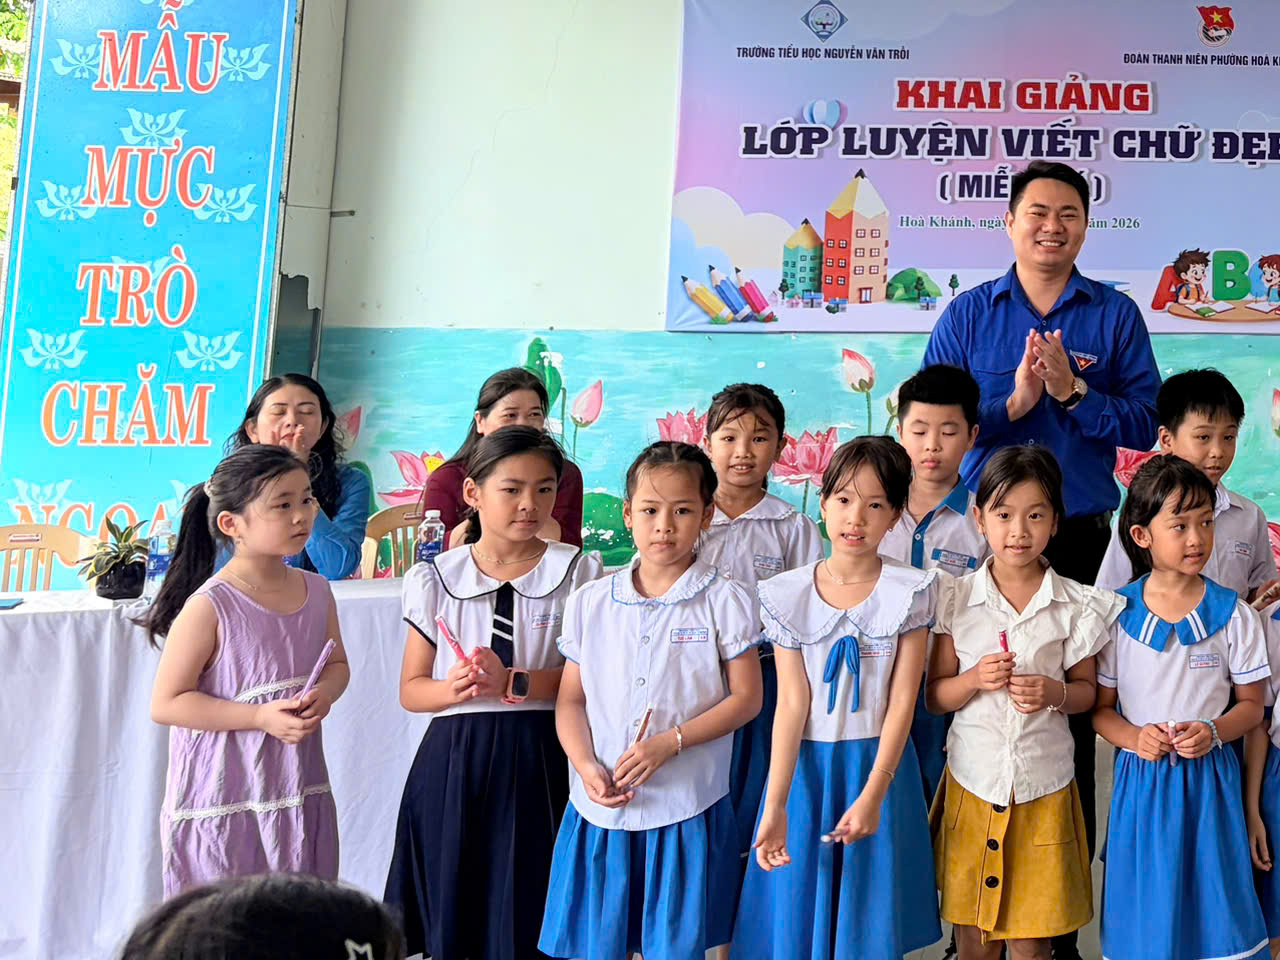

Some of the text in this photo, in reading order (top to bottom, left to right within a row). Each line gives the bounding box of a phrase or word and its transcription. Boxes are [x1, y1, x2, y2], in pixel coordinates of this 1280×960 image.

[736, 45, 775, 58] TRƯỜNG
[802, 47, 821, 61] HỌC
[1152, 53, 1183, 65] THANH
[1186, 52, 1208, 65] NIÊN
[895, 74, 1150, 112] KHAI GIẢNG
[742, 120, 829, 155] LỚP
[841, 121, 989, 162] LUYỆN
[1001, 118, 1100, 158] VIẾT
[1113, 125, 1202, 159] CHỮ
[80, 138, 217, 227] MỰC
[958, 166, 1011, 199] MIỄ
[899, 216, 925, 227] Hoà
[929, 216, 975, 229] Khánh,
[1088, 218, 1108, 228] ăm
[1111, 218, 1140, 229] 2026
[77, 244, 198, 327] TRÒ
[42, 363, 216, 446] CHĂM
